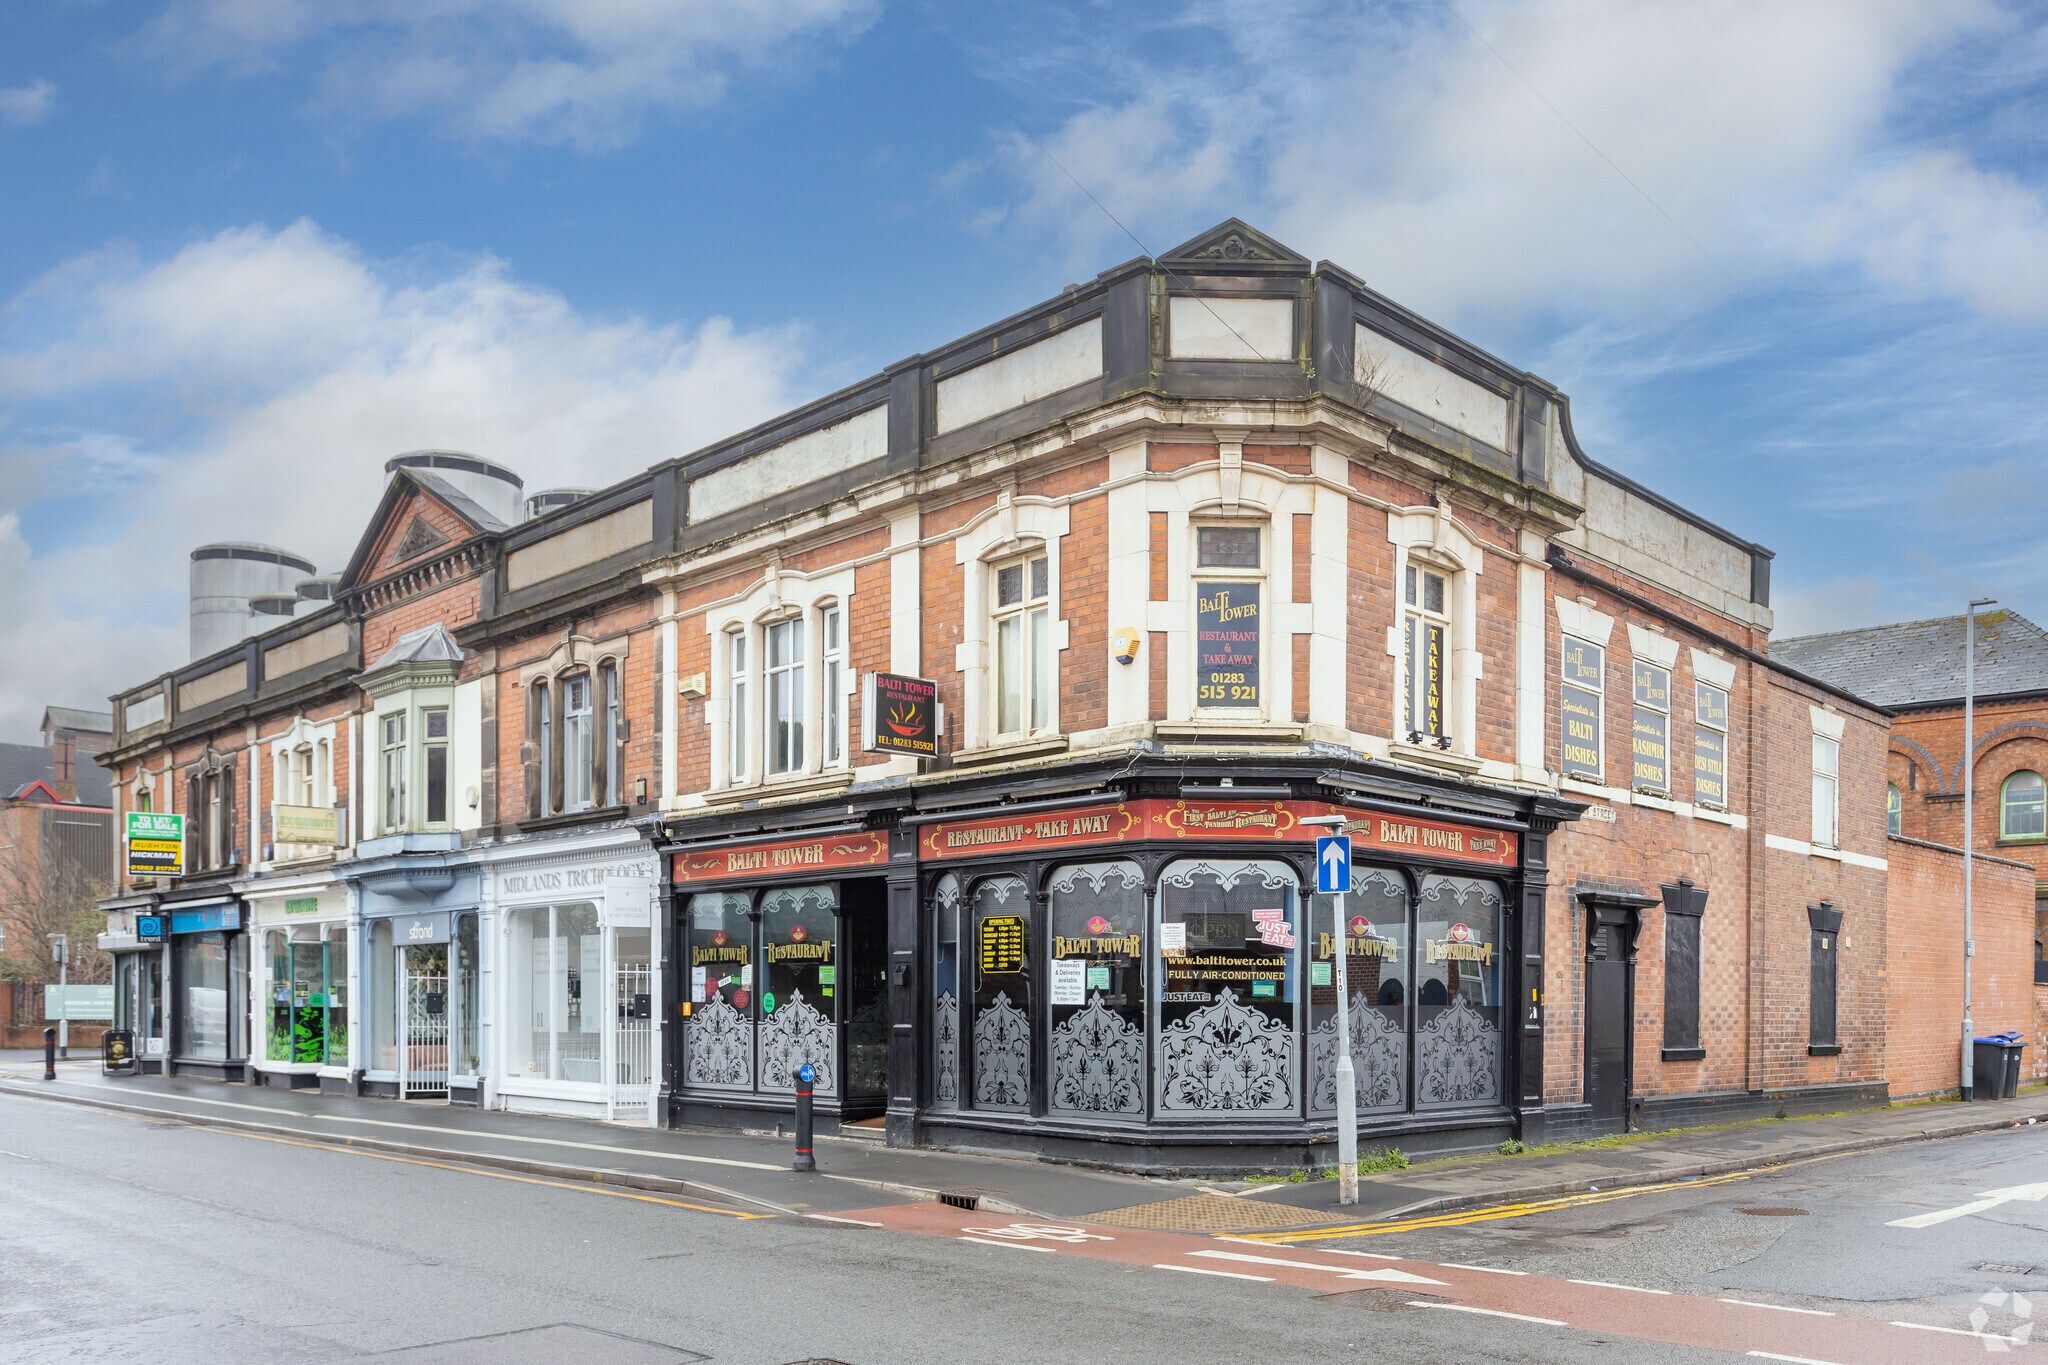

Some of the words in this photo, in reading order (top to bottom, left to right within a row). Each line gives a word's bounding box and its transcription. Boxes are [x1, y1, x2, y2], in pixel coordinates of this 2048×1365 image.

[1200, 631, 1257, 641] RESTAURANT
[1224, 643, 1232, 652] &
[1203, 654, 1226, 664] TAKE
[1228, 655, 1253, 665] AWAY
[878, 677, 902, 689] BALTI
[904, 681, 934, 696] TOWER
[1211, 672, 1245, 683] 01283
[1428, 629, 1439, 735] TAKEAWAY
[886, 691, 925, 703] RESTAURANT
[1200, 685, 1225, 699] 515
[1231, 686, 1256, 699] 921
[1563, 699, 1588, 715] Specialists
[1569, 720, 1593, 740] BALTI
[878, 735, 892, 744] TEL:
[893, 737, 911, 748] 01283
[913, 740, 934, 751] 515921
[1633, 738, 1664, 760] KASHMIR
[1565, 743, 1597, 766] DISHES
[1634, 761, 1663, 782] DISHES
[1695, 755, 1707, 770] DESI
[1708, 758, 1722, 775] STYLE
[1696, 778, 1721, 797] DISHES
[1183, 810, 1204, 822] FIRST
[1208, 810, 1226, 820] BALTI
[1236, 813, 1278, 828] RESTAURANT
[947, 824, 1024, 847] RESTAURANT
[1035, 819, 1068, 839] TAKE
[1072, 815, 1111, 835] AWAY
[1380, 820, 1418, 845] BALTI
[1421, 828, 1463, 852] TOWER
[130, 851, 176, 859] HICKMAN
[727, 851, 767, 872] BALTI
[771, 843, 824, 867] TOWER
[503, 871, 562, 894] MIDLANDS
[1259, 920, 1289, 934] JUST
[1055, 936, 1092, 959] BALTI
[1096, 934, 1141, 957] TOWER
[1264, 932, 1286, 945] EAT
[1319, 932, 1356, 959] BATI
[1358, 937, 1398, 962] TOWER
[692, 946, 717, 966] BALTI
[719, 945, 748, 965] TOWER
[768, 940, 831, 963] RESTAURANT
[1168, 956, 1287, 966] www.baltitower.co.uk
[1426, 939, 1492, 965] RESTAURANT
[1169, 970, 1200, 979] FULLY
[1202, 971, 1286, 980] AIR-CONDITIONED
[1163, 993, 1184, 1001] JUST
